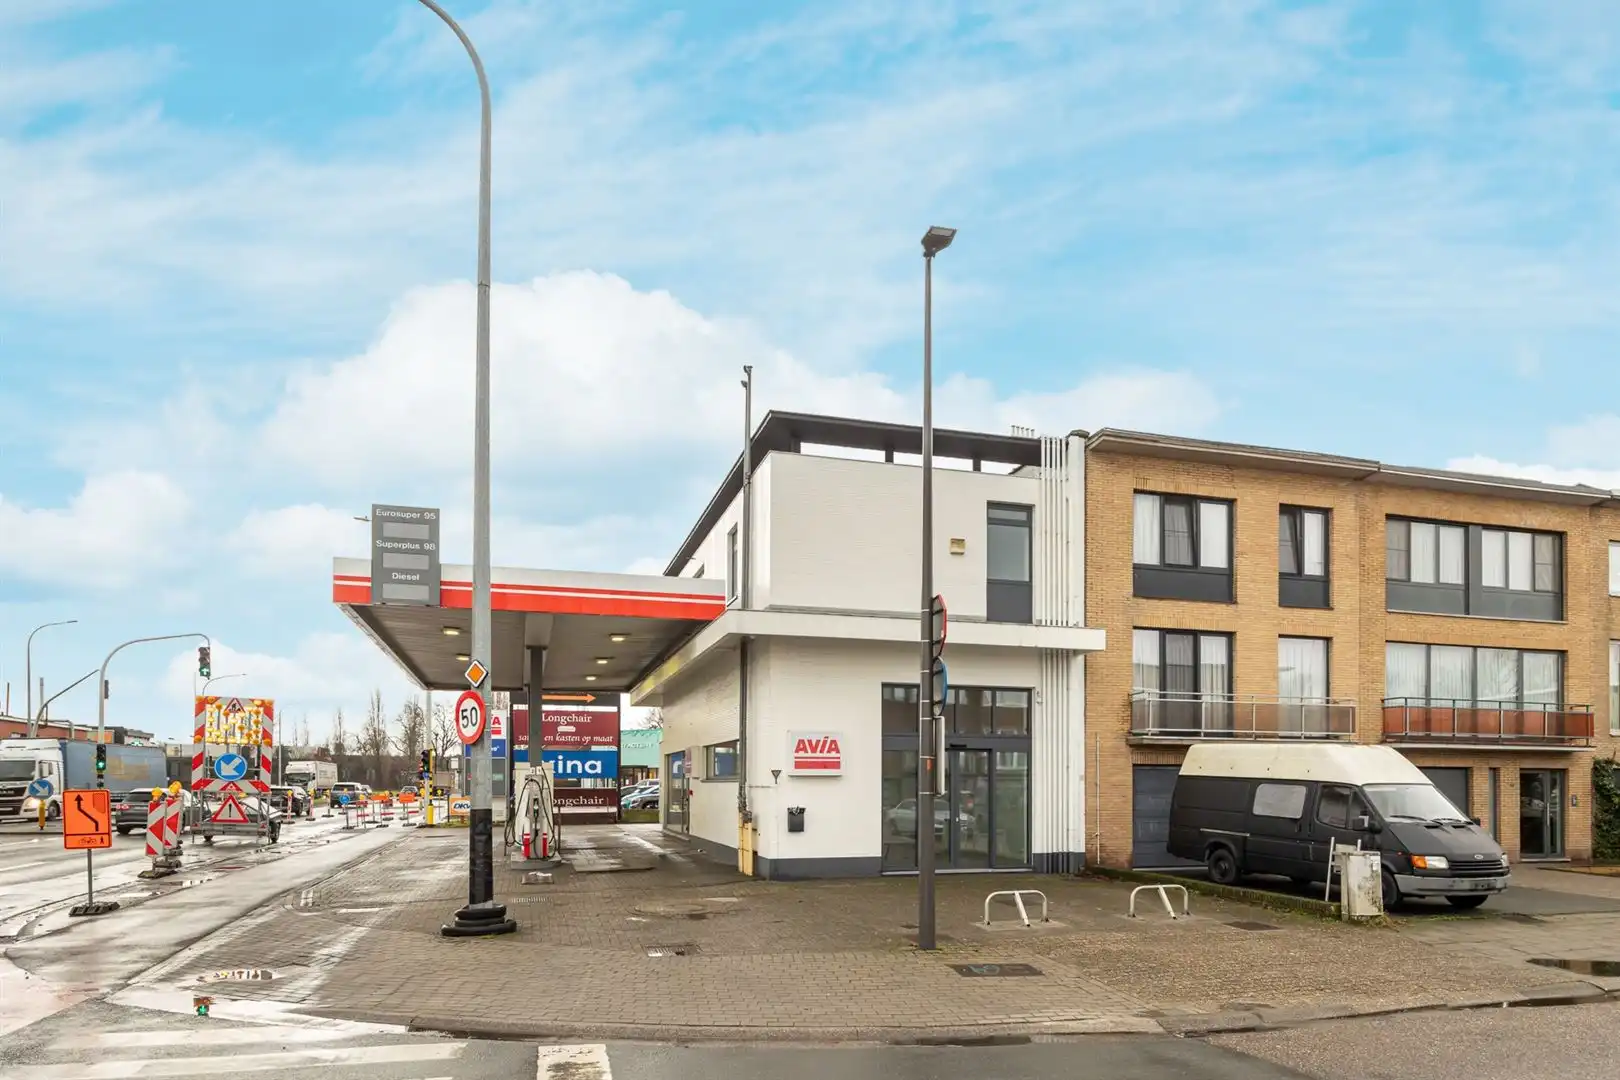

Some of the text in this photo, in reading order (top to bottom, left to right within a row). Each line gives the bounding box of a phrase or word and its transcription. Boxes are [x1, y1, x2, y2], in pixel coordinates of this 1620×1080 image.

[376, 509, 436, 520] Eurosuper 95
[376, 540, 436, 551] Superplus 98
[392, 572, 420, 580] Diesel
[461, 706, 478, 728] 50
[542, 713, 592, 724] Longchair
[552, 755, 602, 773] ina
[552, 796, 604, 806] ongchair
